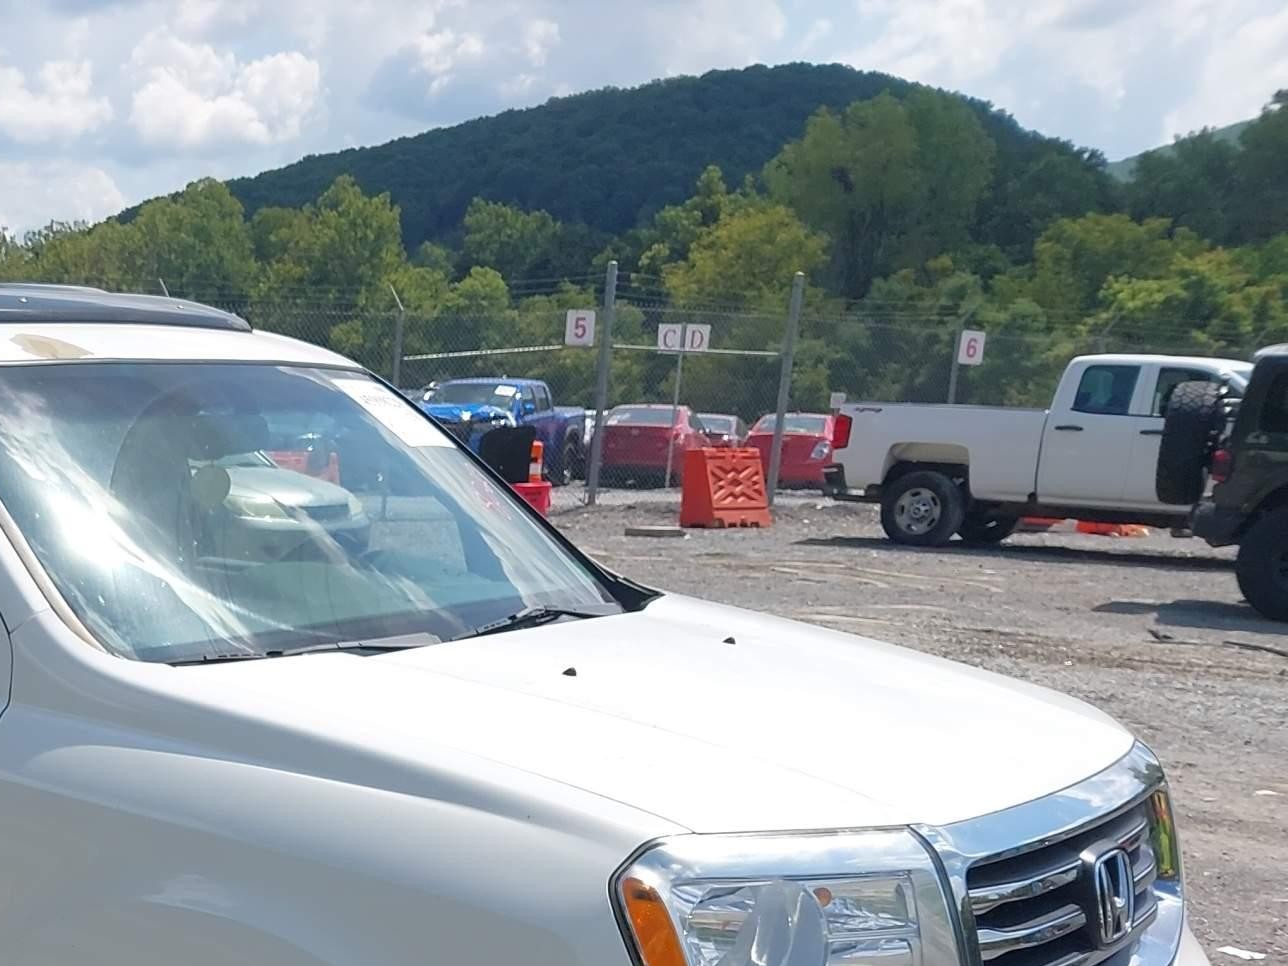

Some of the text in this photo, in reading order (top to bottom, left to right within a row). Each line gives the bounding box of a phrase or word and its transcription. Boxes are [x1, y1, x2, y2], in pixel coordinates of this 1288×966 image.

[574, 316, 587, 339] 5
[663, 329, 677, 348] C
[690, 329, 704, 350] D
[966, 337, 978, 358] 6
